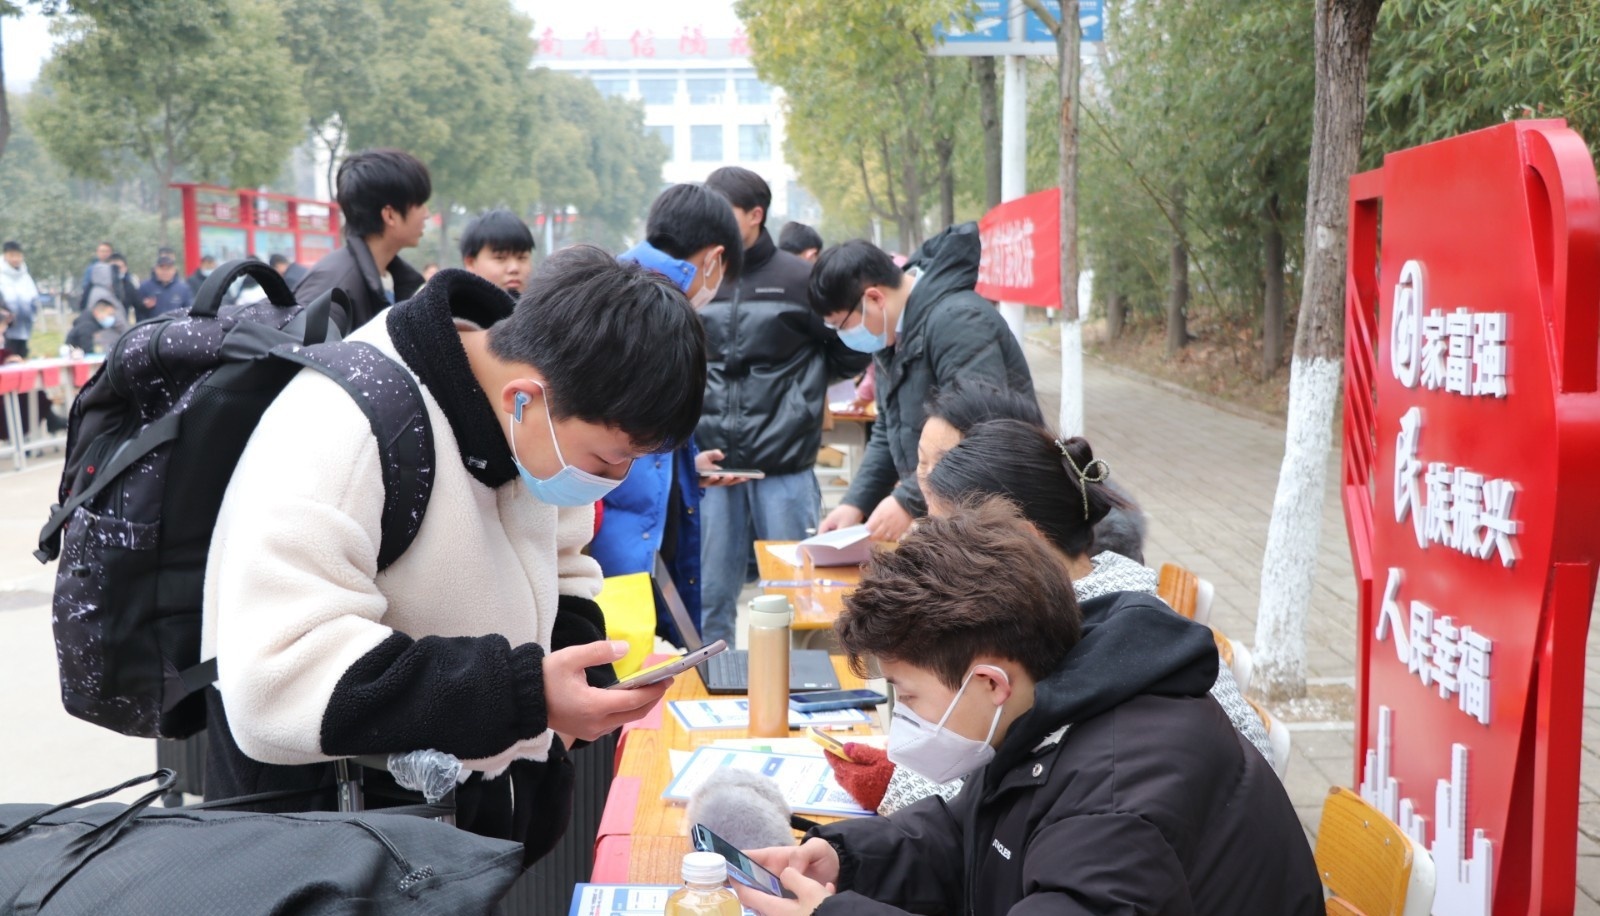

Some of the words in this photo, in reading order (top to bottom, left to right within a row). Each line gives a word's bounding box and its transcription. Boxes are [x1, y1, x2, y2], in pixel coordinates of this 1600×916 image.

[1391, 259, 1509, 398] 国家富强
[1394, 406, 1517, 567] 民族振兴
[1376, 567, 1492, 725] 人民幸福
